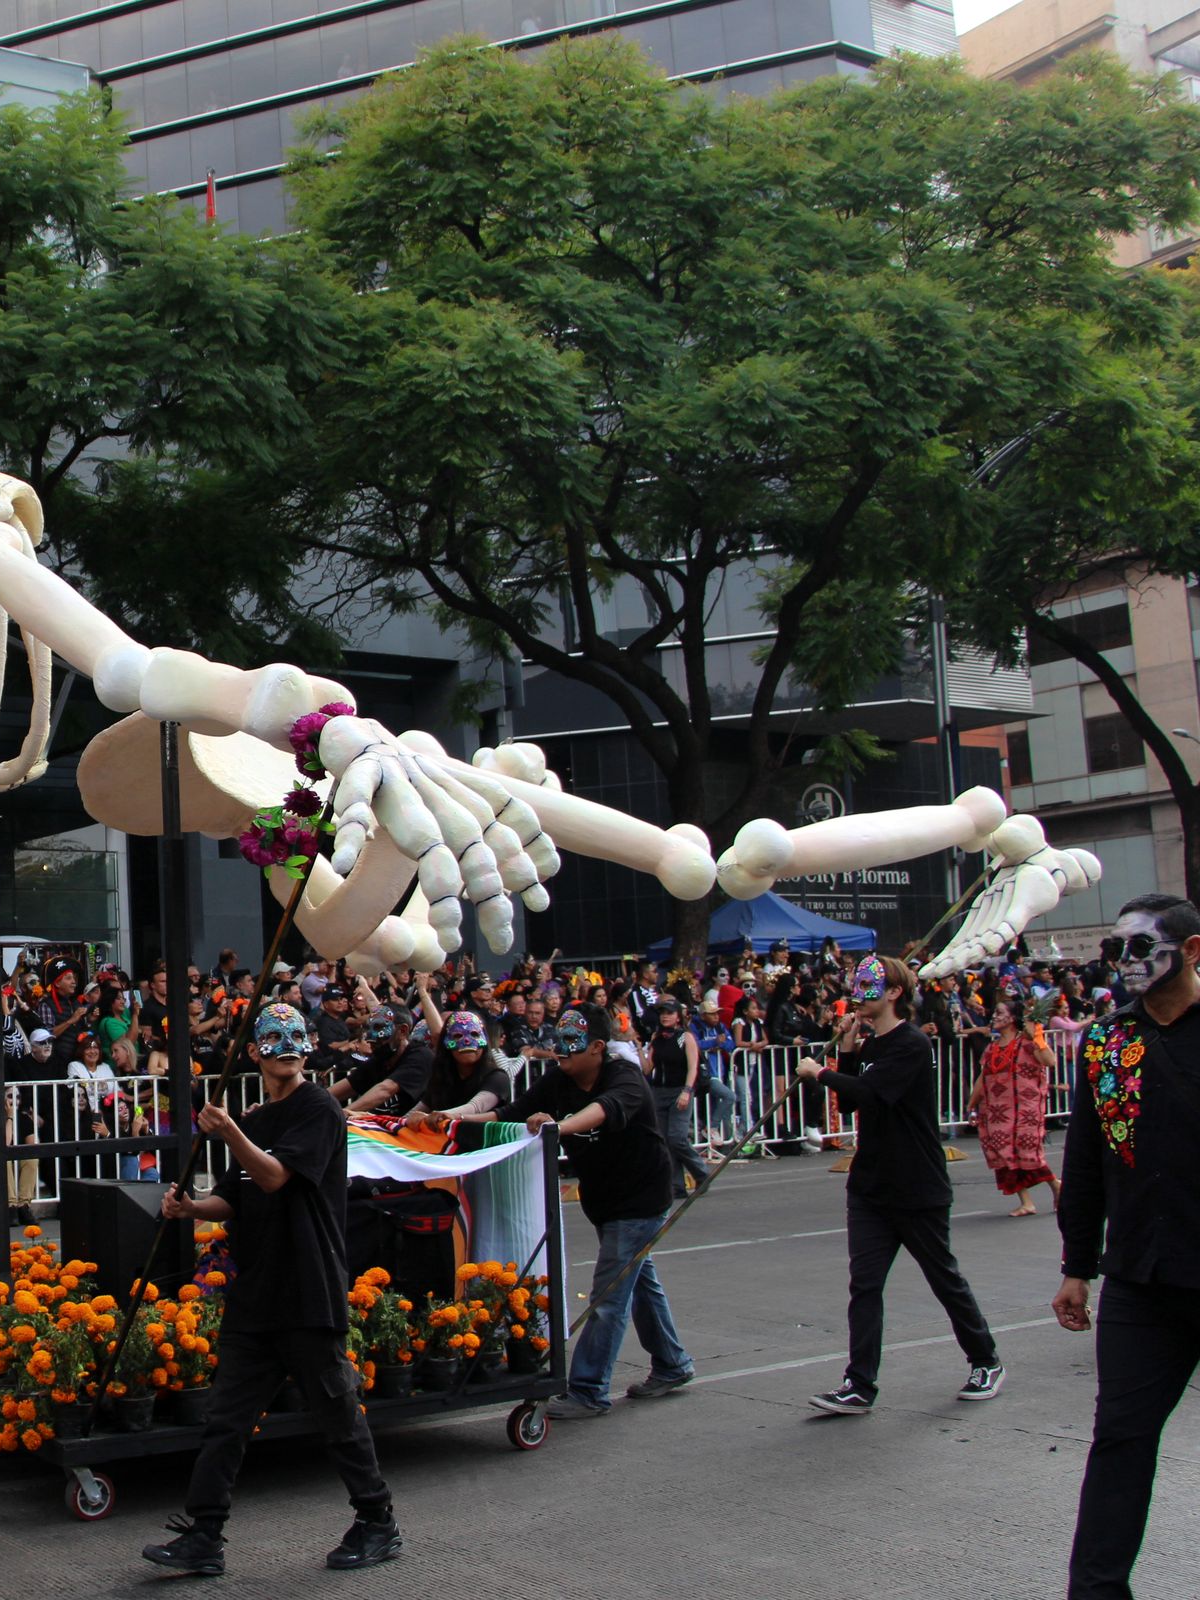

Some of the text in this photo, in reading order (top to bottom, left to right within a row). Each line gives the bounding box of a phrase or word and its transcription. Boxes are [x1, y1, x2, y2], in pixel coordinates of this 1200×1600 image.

[843, 869, 910, 885] Rforma
[826, 901, 837, 909] DE
[839, 901, 898, 910] CONENCIONES
